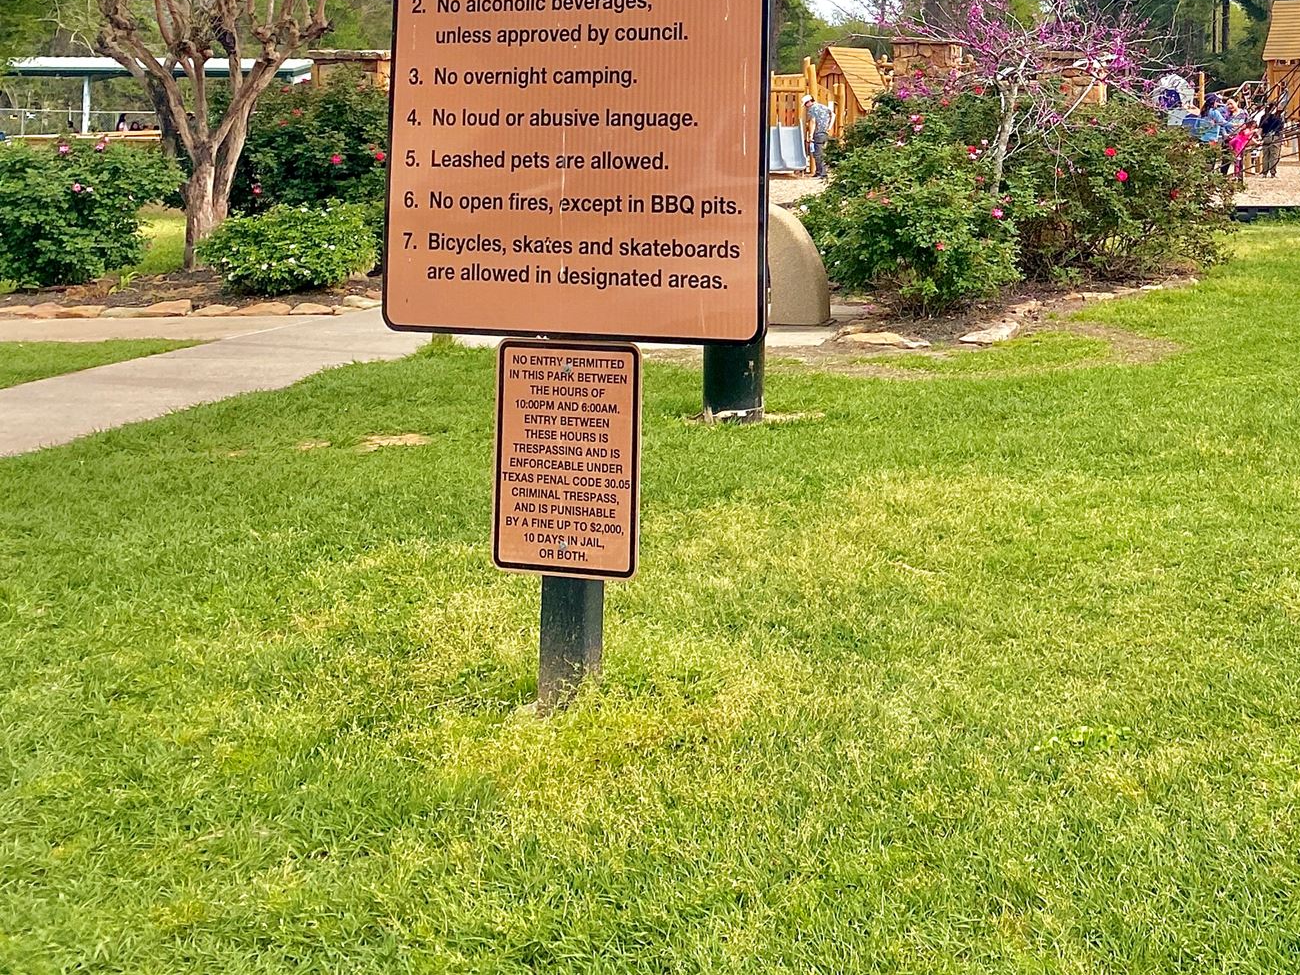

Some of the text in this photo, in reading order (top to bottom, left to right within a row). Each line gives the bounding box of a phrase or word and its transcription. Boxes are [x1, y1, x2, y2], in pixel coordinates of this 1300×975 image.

[436, 23, 689, 48] unless approved by council.
[409, 67, 638, 88] 3. No overnight camping.
[407, 108, 699, 131] 4. No loud or abusive language.
[405, 149, 669, 173] 5. Leashed pets are allowed.
[404, 191, 742, 219] 6. No open fires, except in BBQ pits.
[403, 232, 741, 259] 7. Bicycles, skates and skateboards
[427, 263, 728, 290] are allowed in designated areas.
[513, 355, 624, 369] NO ENTRY PERMITTED
[510, 370, 627, 384] IN THIS PARK BETWEEN
[530, 385, 605, 398] THE HOURS OF
[515, 400, 620, 414] 10:00PM AND 6:00AM.
[525, 415, 609, 428] ENTRY BETWEEN
[525, 429, 608, 443] THESE HOURS IS
[513, 443, 620, 458] TRESPASSING AND IS
[510, 458, 623, 474] ENFORCEABLE UNDER
[502, 472, 630, 489] TEXAS PENAL CODE 30.05
[511, 488, 619, 505] CRIMINAL TRESPASS,
[514, 503, 615, 518] AND IS PUNISHABLE
[506, 517, 519, 526] BY
[522, 518, 529, 527] A
[532, 519, 554, 529] FINE
[557, 521, 570, 530] UP
[573, 522, 587, 531] TO
[524, 533, 604, 549] 10 DAYS IN JAIL,
[539, 549, 588, 562] OR BOTH.
